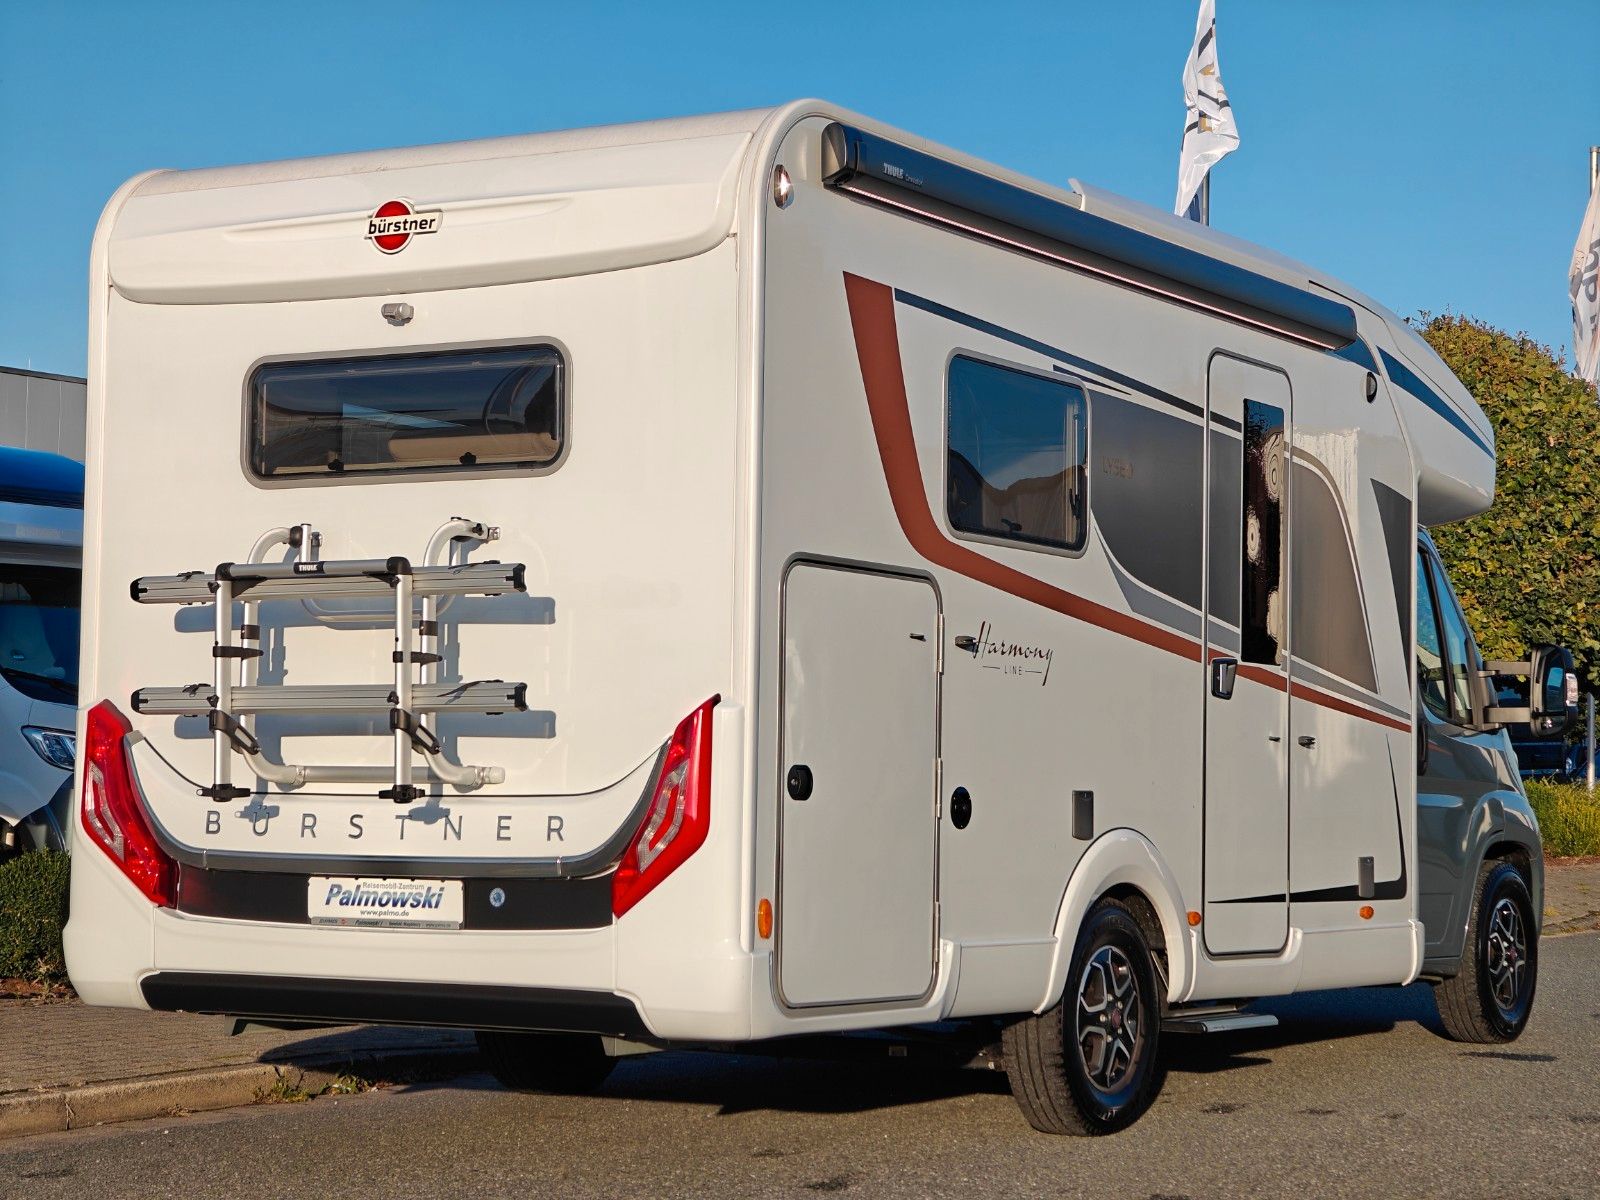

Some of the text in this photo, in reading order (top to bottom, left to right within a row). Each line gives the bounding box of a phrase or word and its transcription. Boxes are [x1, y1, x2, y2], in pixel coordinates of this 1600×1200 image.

[883, 162, 904, 179] THULE
[368, 218, 436, 235] bürstner
[298, 564, 318, 572] THULE
[973, 620, 1053, 687] Harmony
[1004, 665, 1022, 676] LINE
[204, 803, 565, 842] BÜRSTNER
[362, 881, 425, 891] Reisemobil-Zentrum
[324, 883, 445, 910] Palmowski
[359, 908, 410, 918] www.palmo.de
